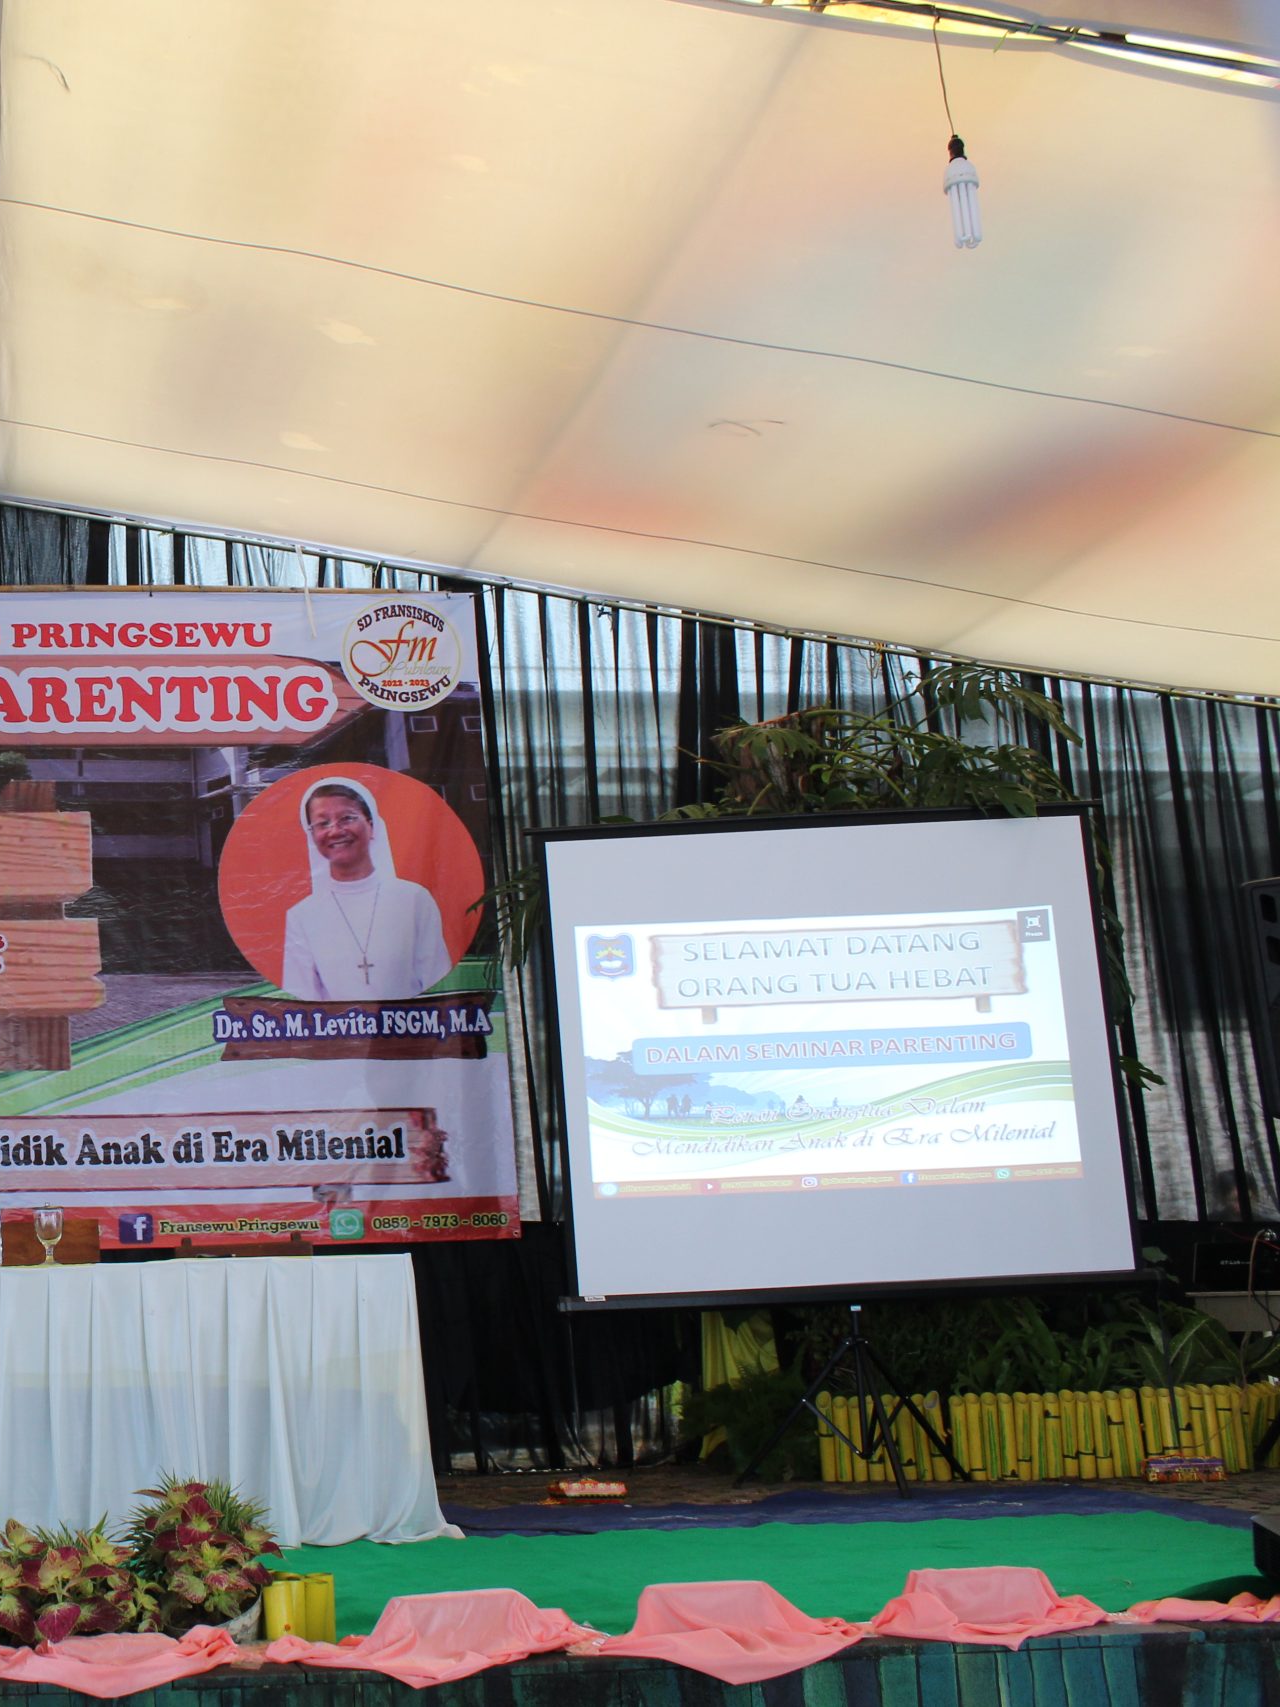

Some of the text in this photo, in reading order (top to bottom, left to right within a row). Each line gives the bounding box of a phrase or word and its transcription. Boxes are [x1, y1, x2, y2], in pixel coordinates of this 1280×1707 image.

[357, 605, 445, 632] SD FRANSISKUS
[11, 622, 272, 648] PRINGSEWU
[358, 675, 451, 703] PRINGSEWU
[410, 679, 430, 687] 2023
[684, 931, 980, 962] SELAMAT DATANG
[677, 966, 993, 998] ORANG TUA HEBAT
[216, 1008, 491, 1039] Dr. Sr. M. Levita FSGM, M.A
[646, 1033, 1016, 1065] DALAM SEMINAR PARENTING
[903, 1097, 986, 1115] Dalam
[75, 1132, 164, 1166] Anak
[172, 1131, 206, 1164] di
[212, 1130, 269, 1163] Era
[276, 1126, 405, 1162] Milenial
[632, 1120, 1057, 1157] Mendidikan Anak di Era Milenial
[160, 1219, 319, 1234] Fransewu Pringsewu
[372, 1216, 409, 1229] 0852
[423, 1215, 458, 1228] 7973
[472, 1213, 508, 1227] 8060
